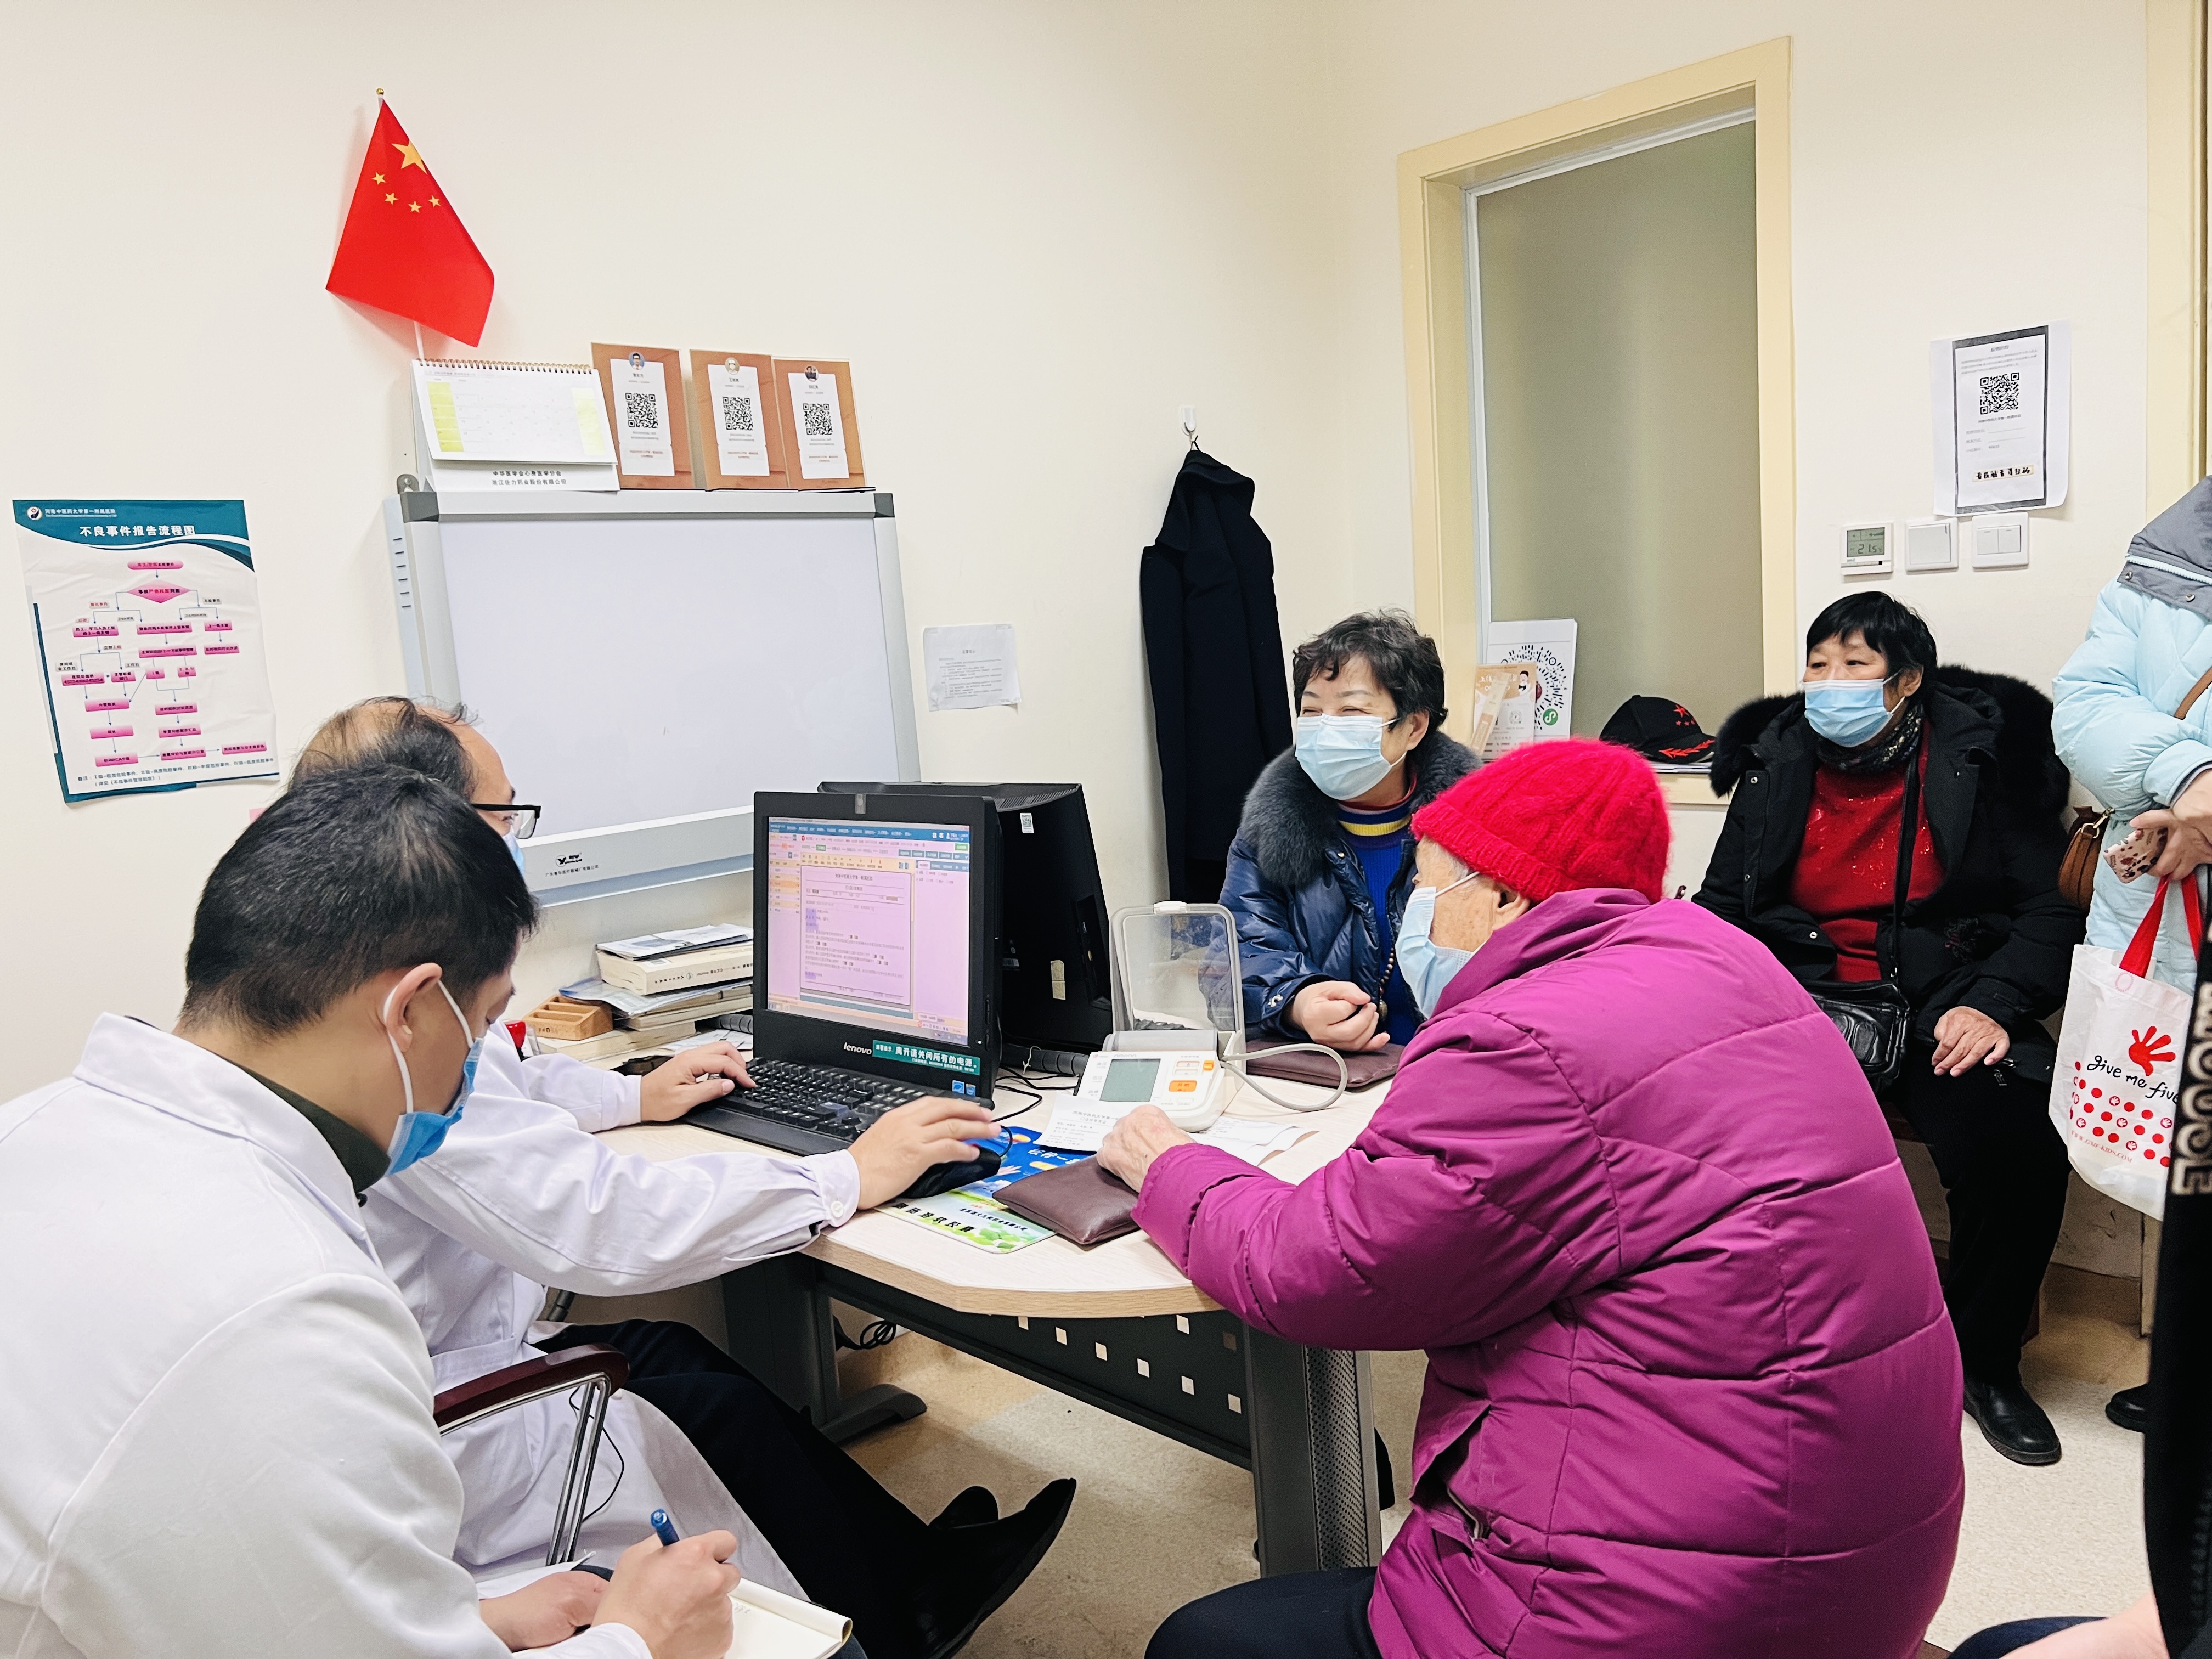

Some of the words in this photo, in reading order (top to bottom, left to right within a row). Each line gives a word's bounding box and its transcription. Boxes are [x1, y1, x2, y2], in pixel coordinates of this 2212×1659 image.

[79, 525, 196, 537] 不良事件报告流程图
[843, 1042, 872, 1055] lenovo
[2126, 1075, 2147, 1088] me
[2145, 1082, 2179, 1104] five
